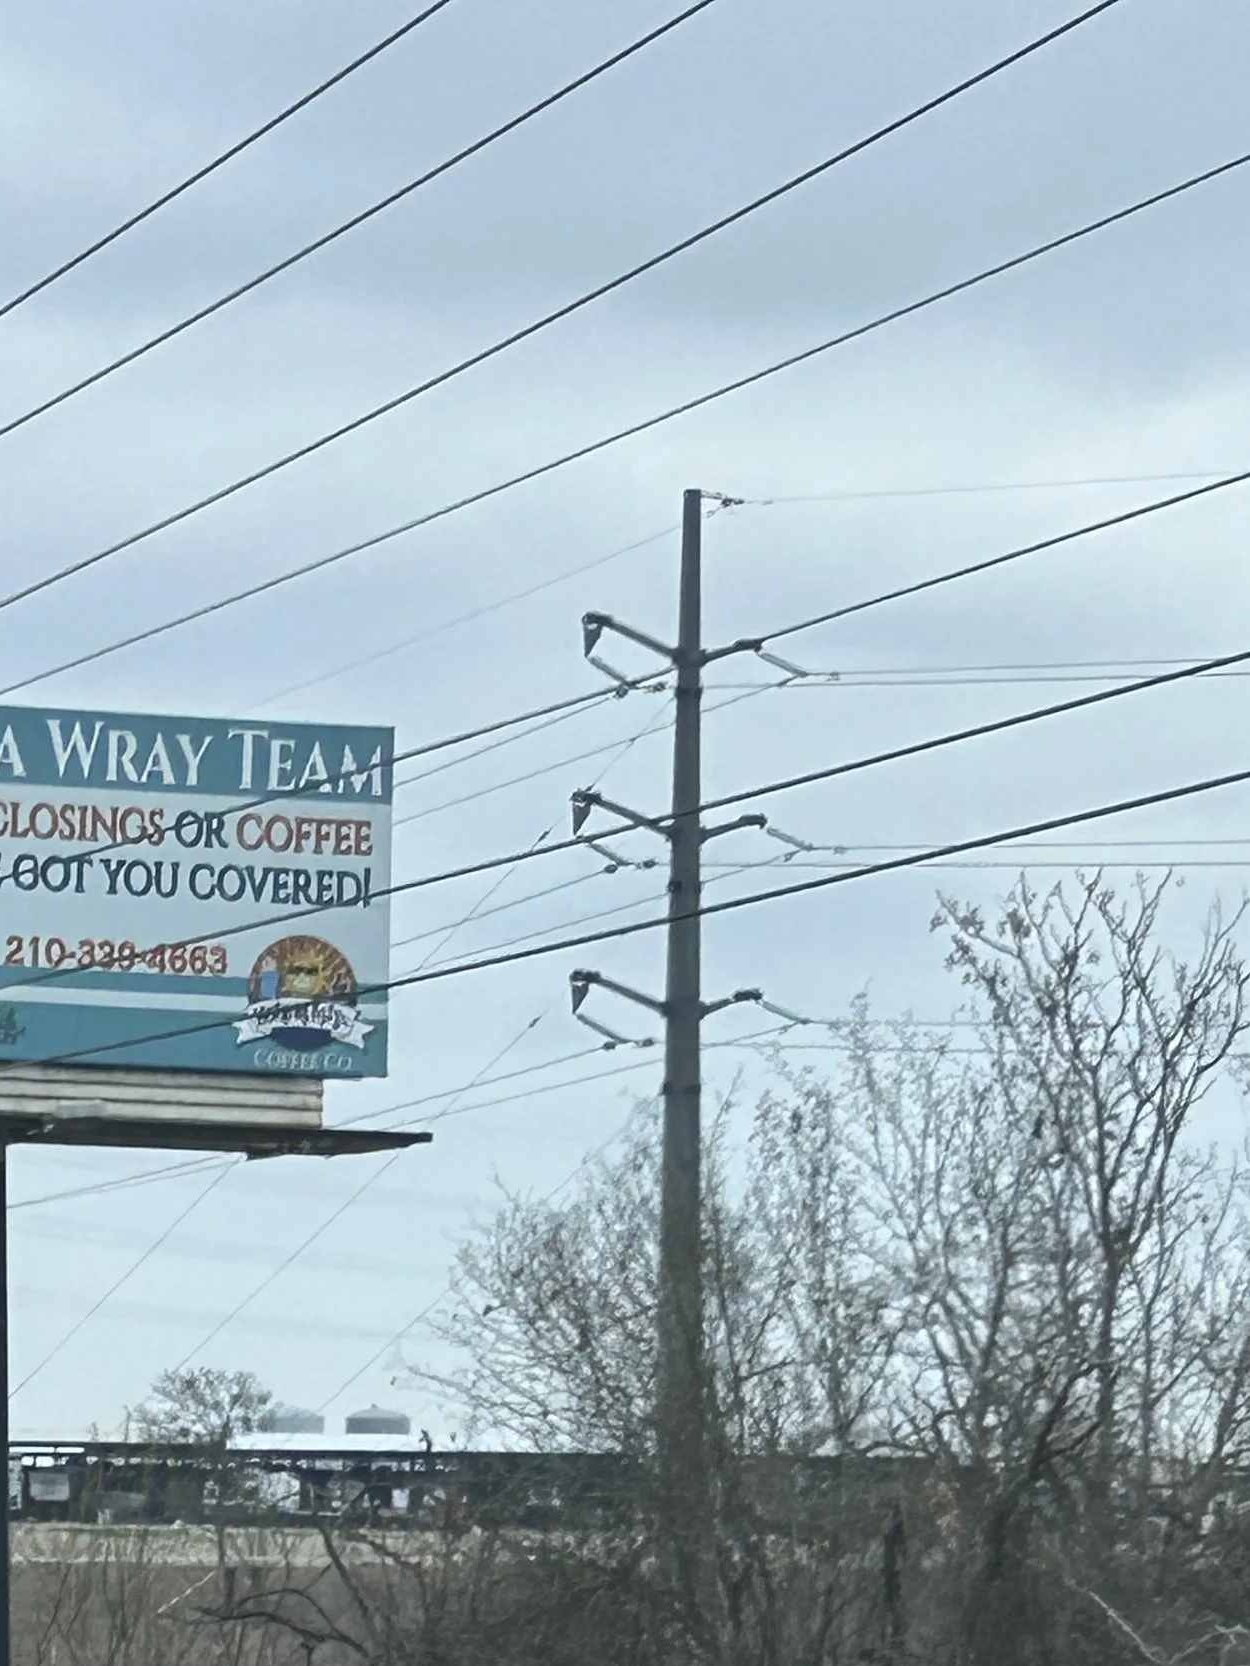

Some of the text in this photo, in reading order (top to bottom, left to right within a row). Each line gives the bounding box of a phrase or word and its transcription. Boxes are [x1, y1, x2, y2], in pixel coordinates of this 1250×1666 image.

[47, 718, 215, 788] WRAY
[227, 727, 384, 797] TEAM
[174, 810, 229, 849] OR
[236, 813, 373, 857] COFFEE
[12, 853, 94, 893] GOT
[100, 858, 180, 898] YOU
[188, 861, 373, 908] COVERED!
